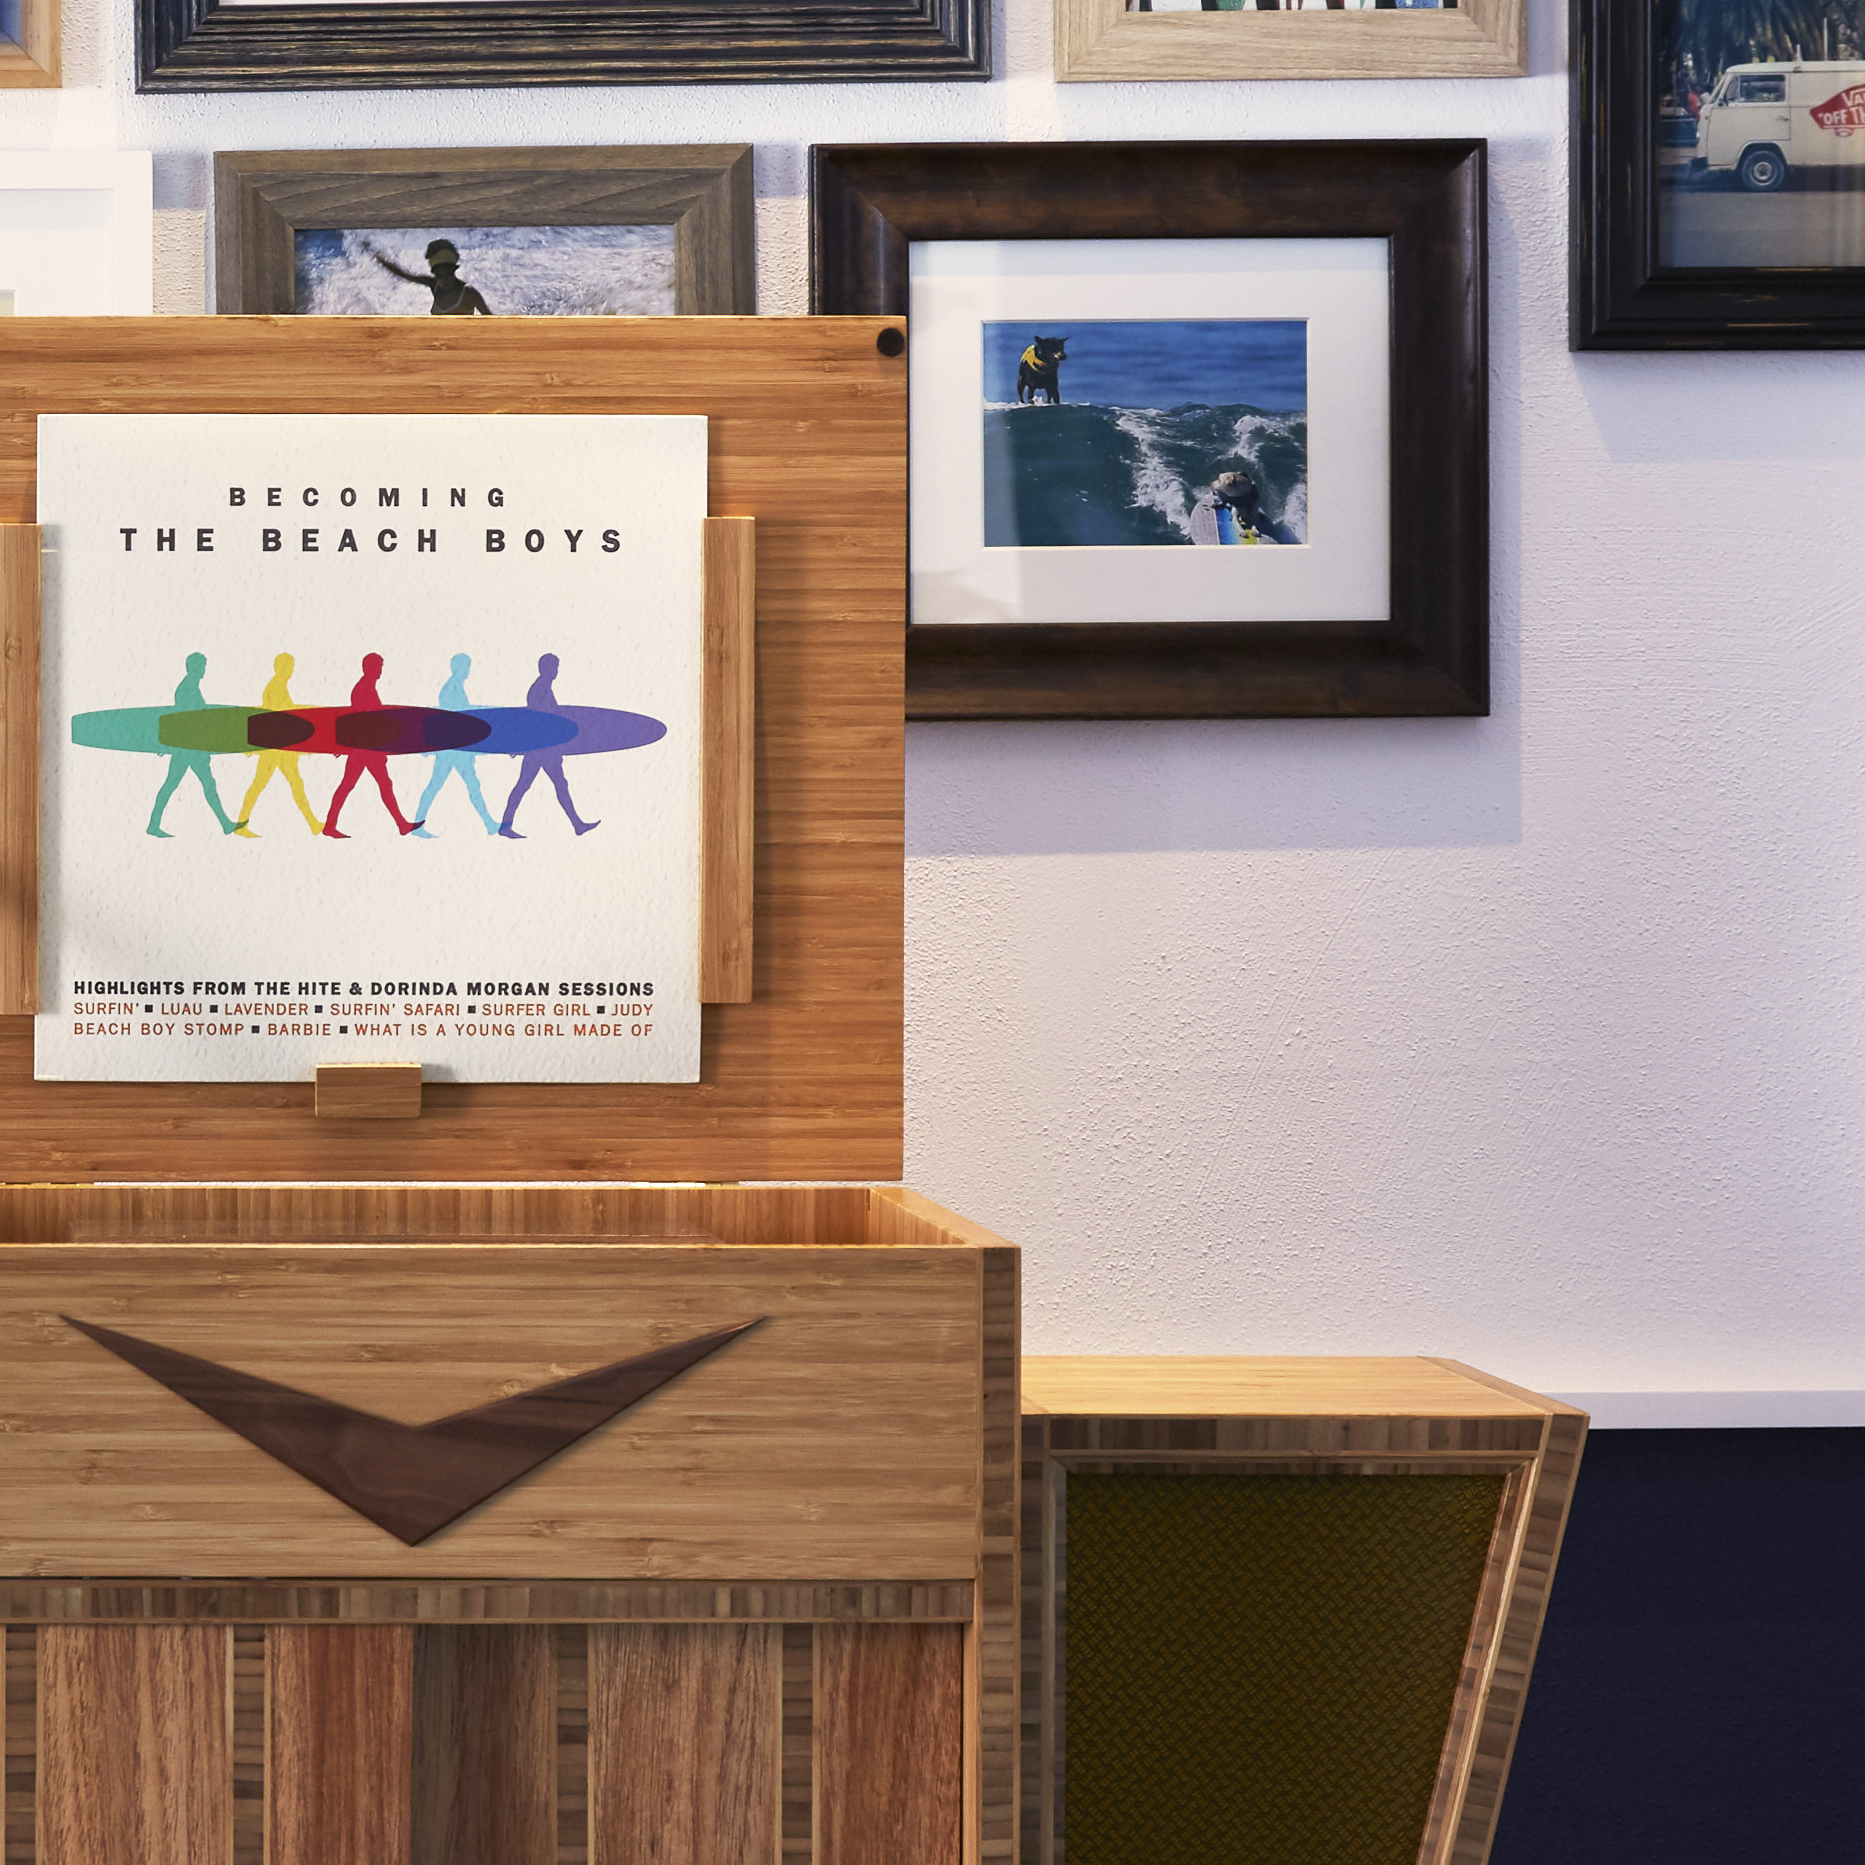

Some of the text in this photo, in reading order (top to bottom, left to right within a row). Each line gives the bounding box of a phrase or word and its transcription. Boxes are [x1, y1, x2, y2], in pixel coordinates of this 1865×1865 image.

[229, 487, 505, 508] BECOMING
[119, 528, 622, 553] THE BEACH BOYS
[73, 981, 655, 996] HIGHLIGHTS FROM THE HITE & DORINDA MORGAN SESSIONS
[73, 1002, 654, 1016] SURFIN' LUAU LAVENDER SURFIN' SAFARI SURFER GIRL JUDY
[73, 1023, 653, 1036] BEACH BOY STOMP BARBIE WHAT IS A YOUNG GIRL MADE OF
